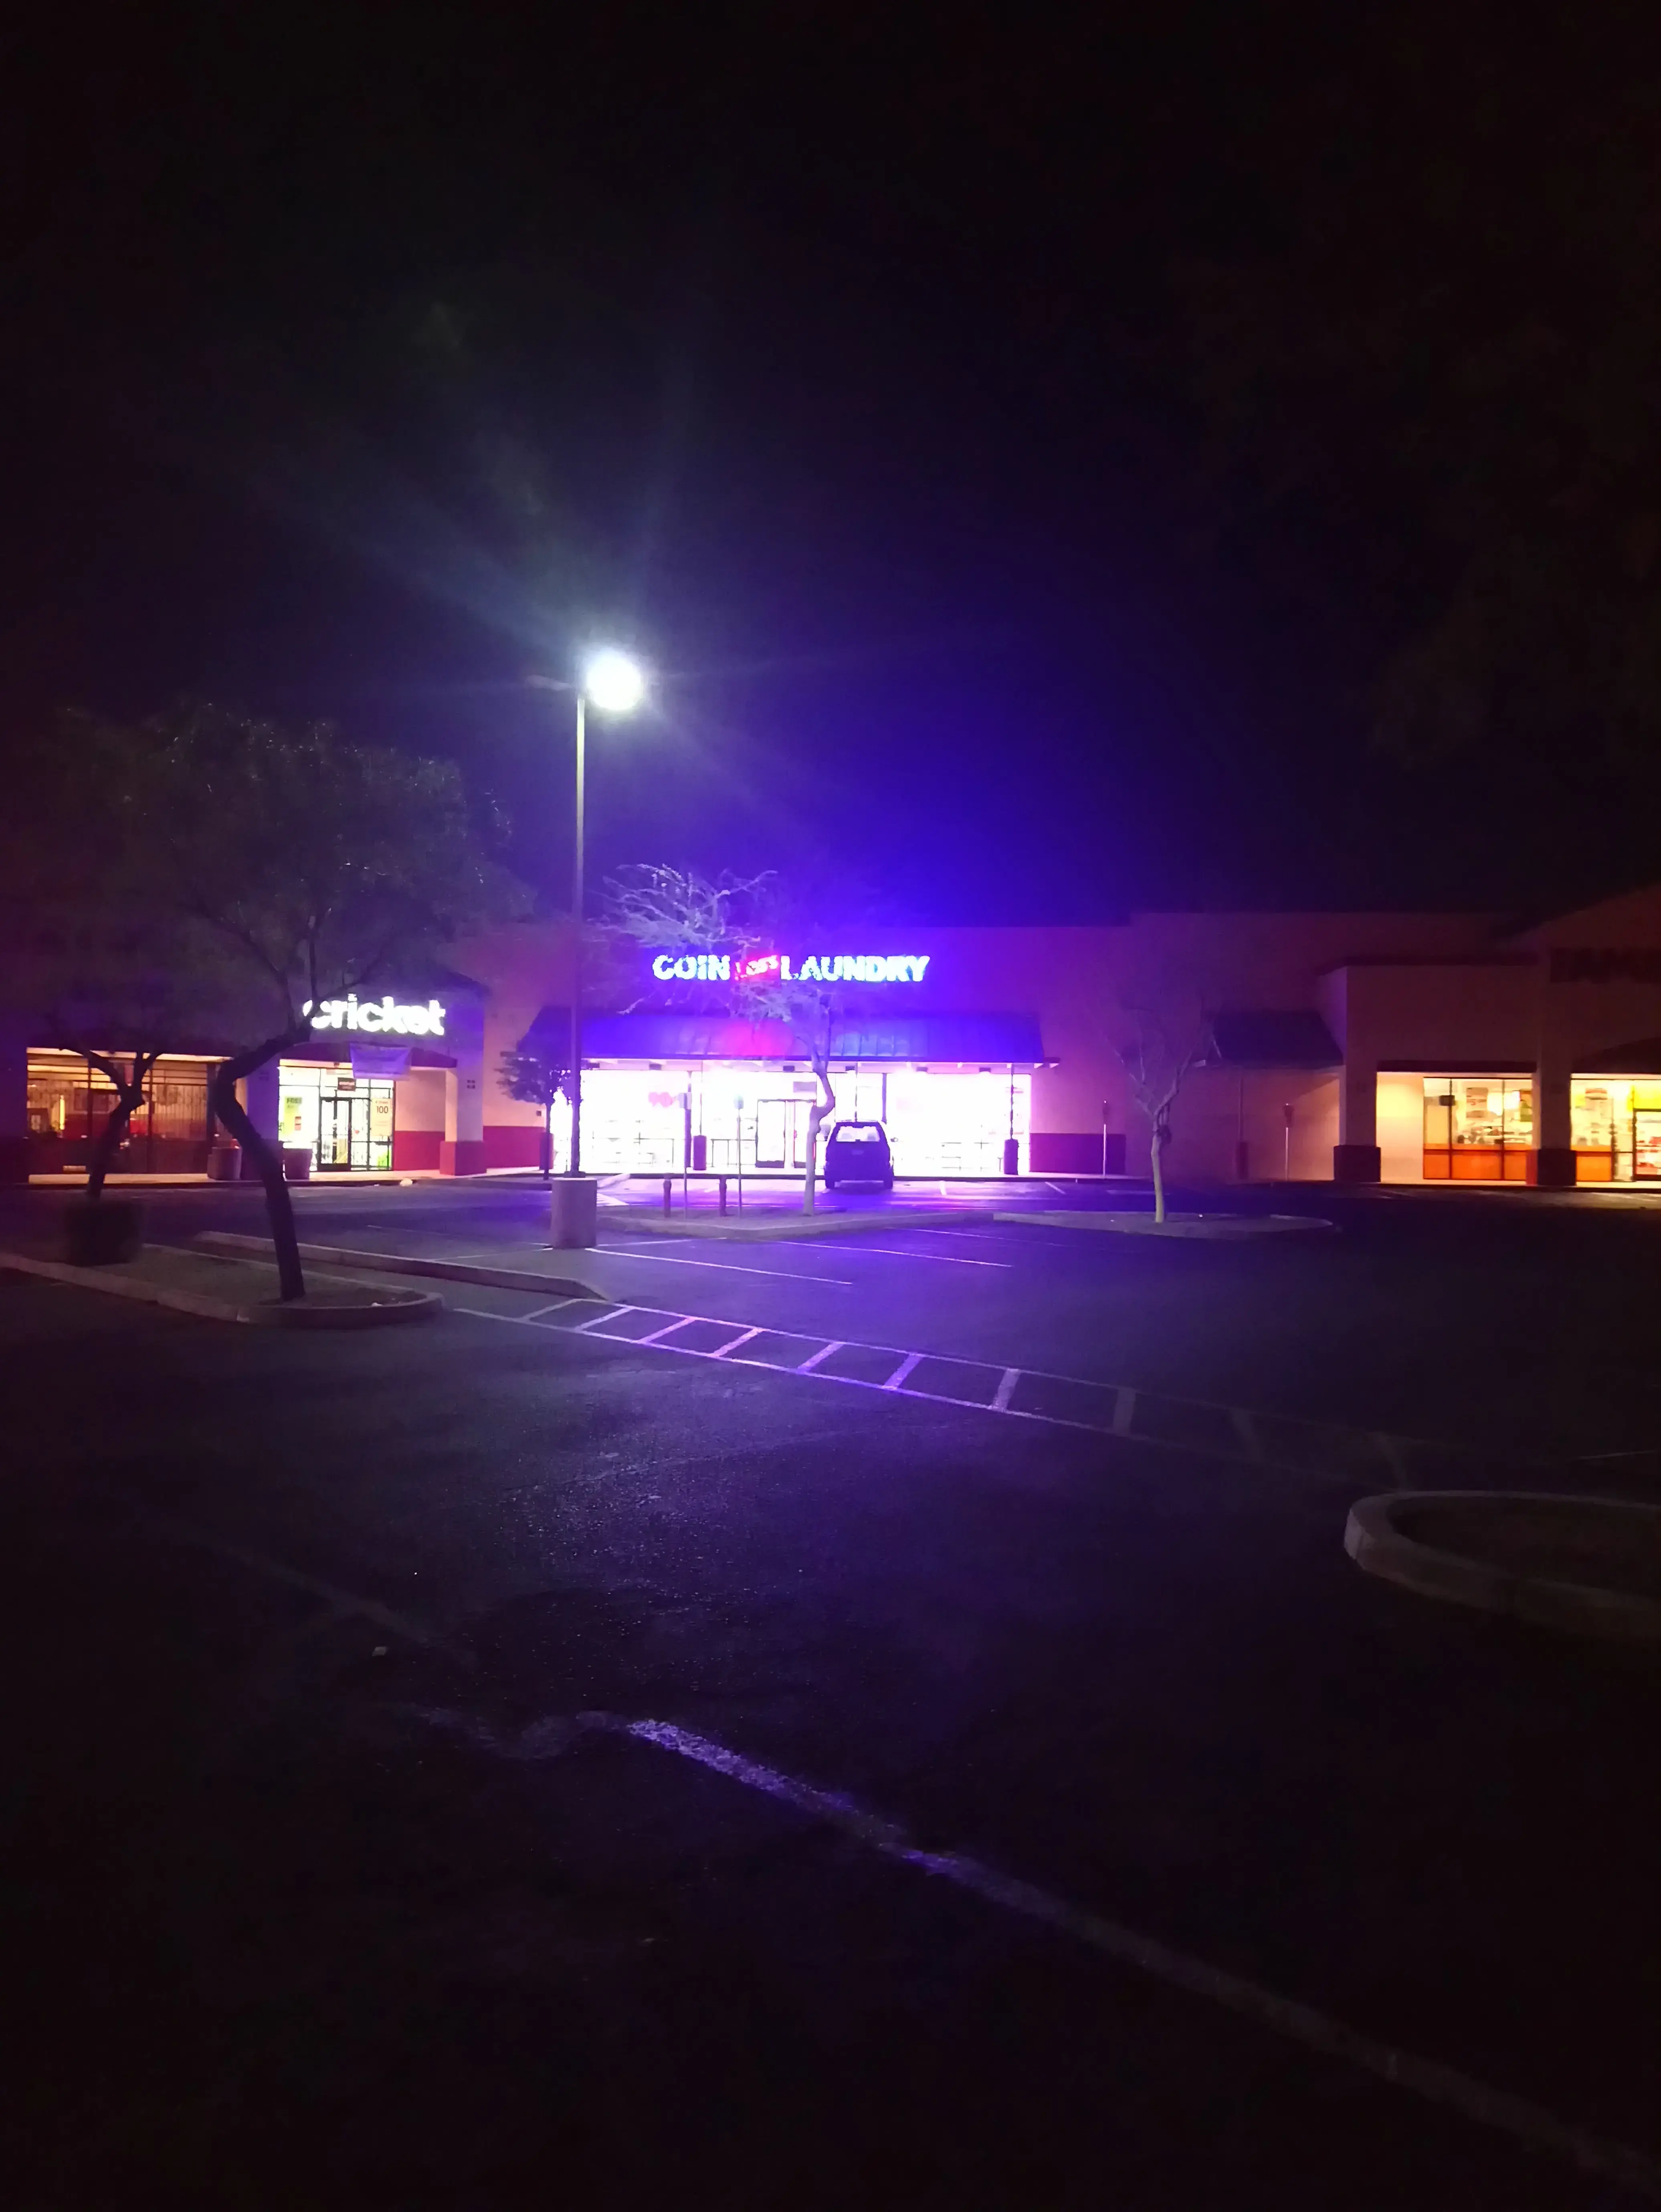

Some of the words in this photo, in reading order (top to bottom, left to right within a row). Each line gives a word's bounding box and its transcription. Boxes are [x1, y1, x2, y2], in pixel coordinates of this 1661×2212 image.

[652, 955, 730, 981] COIN
[780, 955, 930, 982] LAUNDRY
[303, 993, 446, 1035] cricket
[377, 1106, 388, 1114] 100
